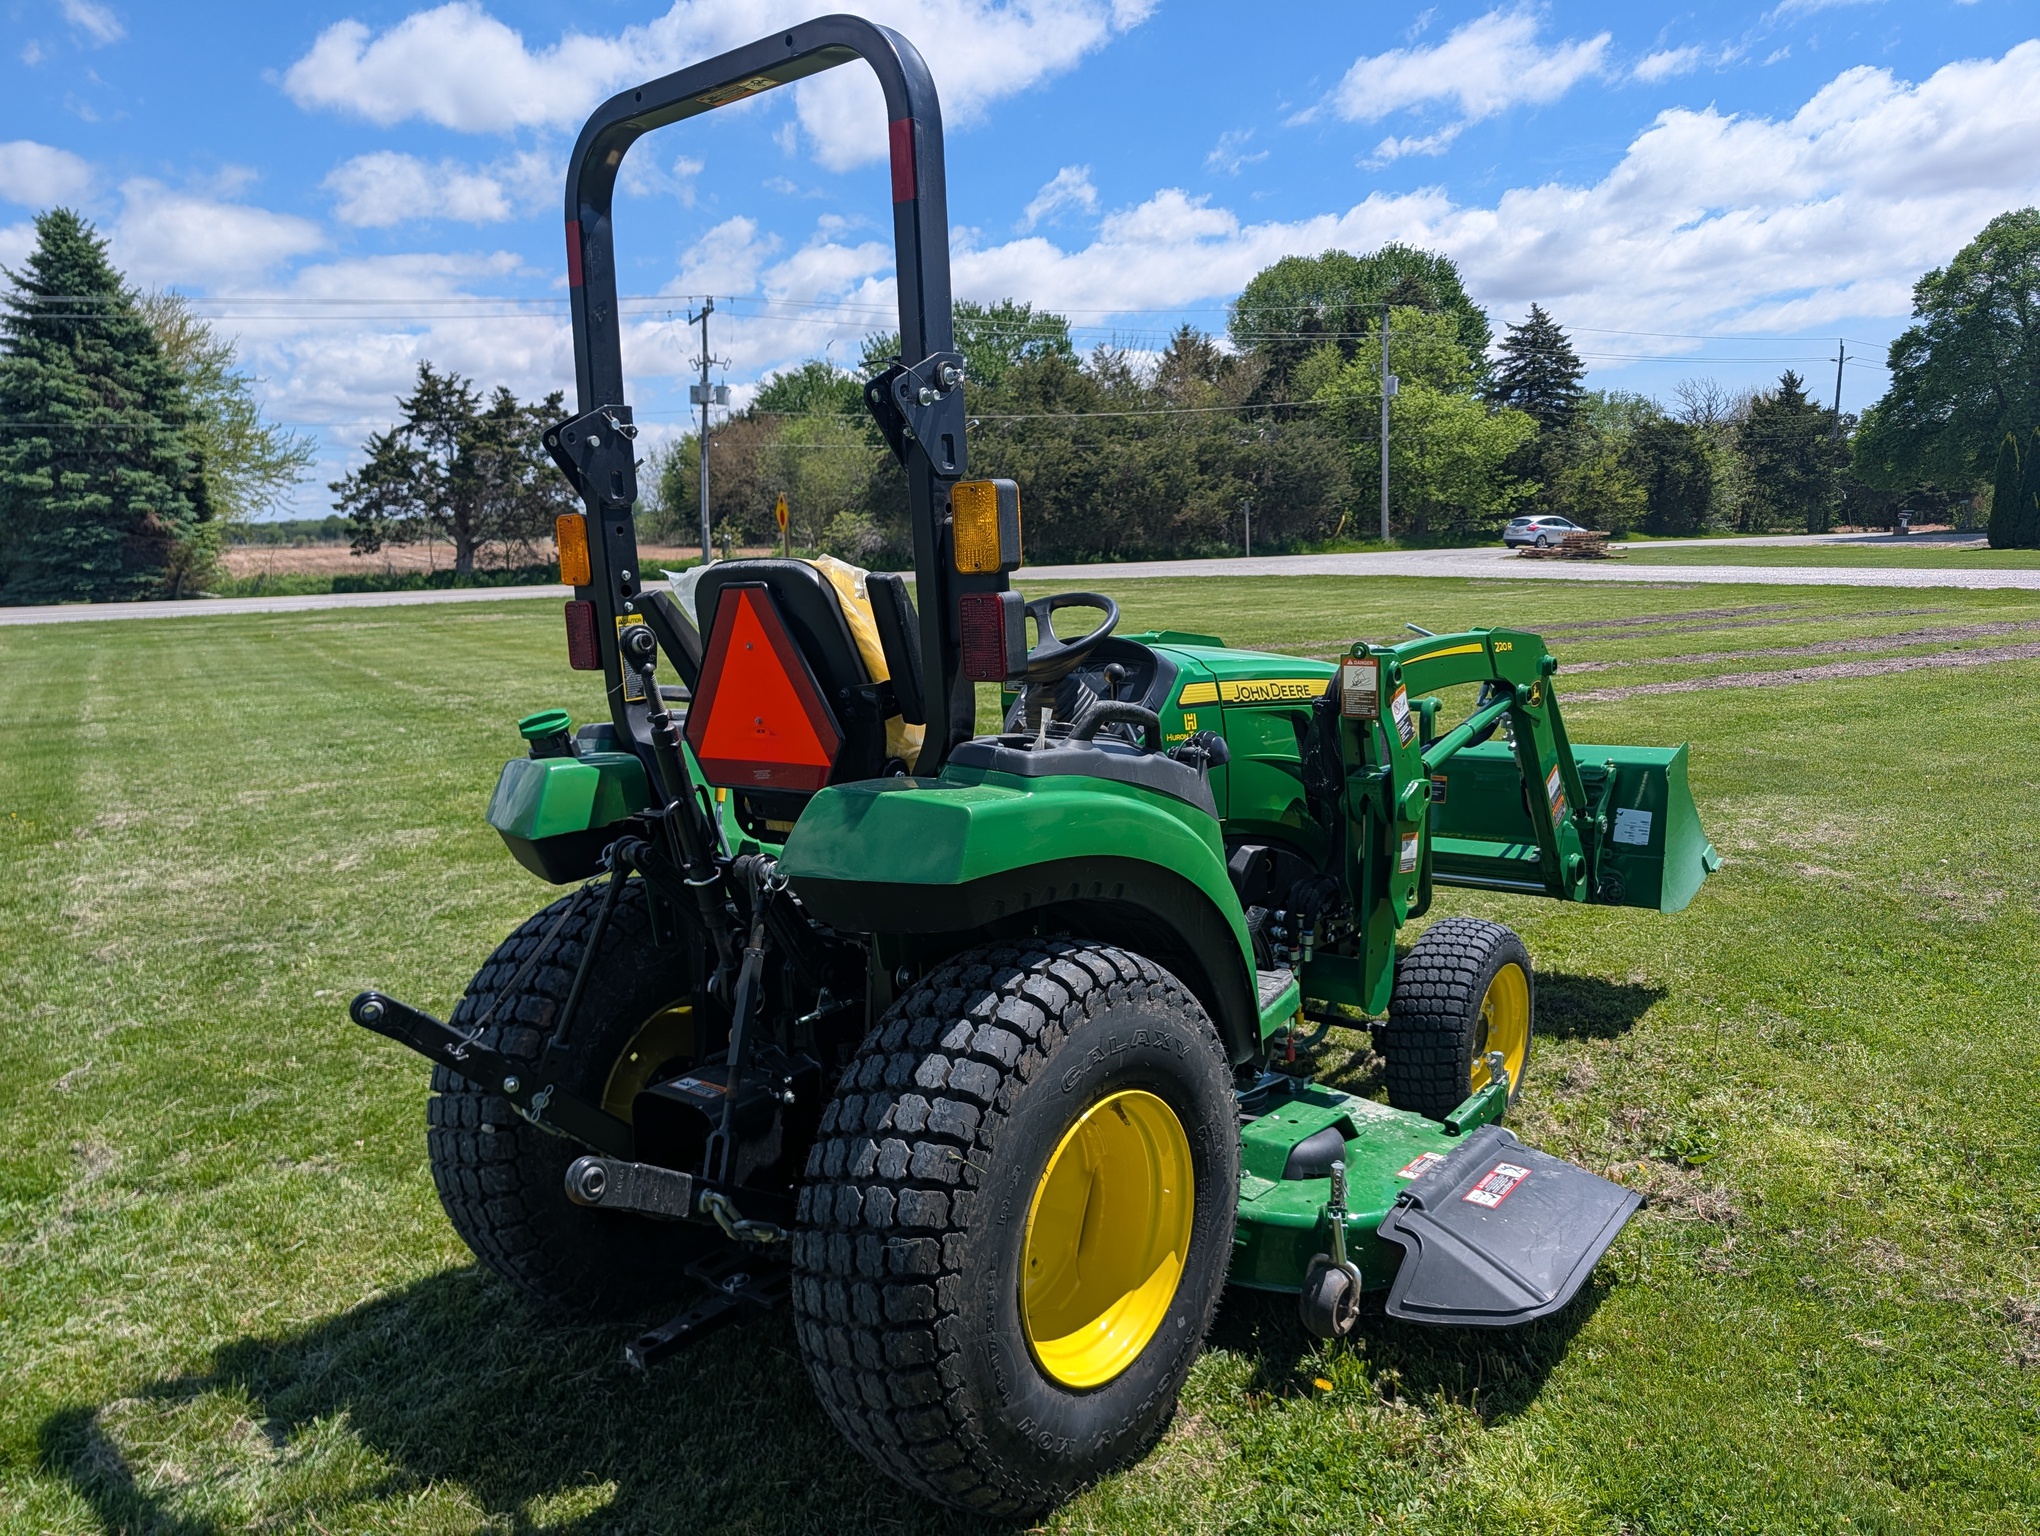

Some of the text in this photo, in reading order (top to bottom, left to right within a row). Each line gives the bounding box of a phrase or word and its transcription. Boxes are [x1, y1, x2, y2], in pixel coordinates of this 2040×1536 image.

[1234, 683, 1311, 700] JOHN DEERE
[1166, 733, 1189, 742] HURON
[1060, 1028, 1192, 1094] GALAXY
[1016, 1414, 1078, 1456] MOW
